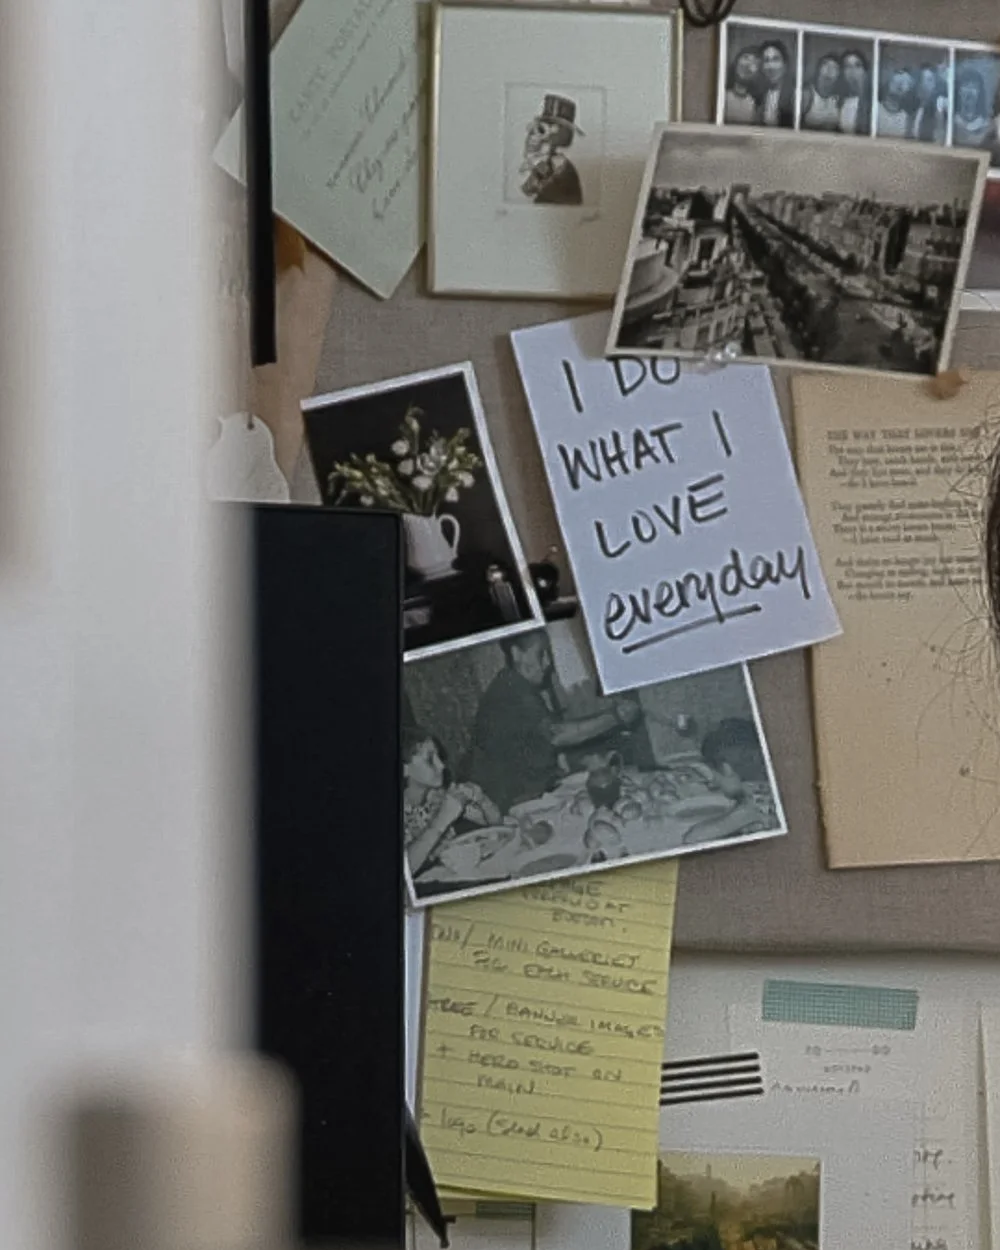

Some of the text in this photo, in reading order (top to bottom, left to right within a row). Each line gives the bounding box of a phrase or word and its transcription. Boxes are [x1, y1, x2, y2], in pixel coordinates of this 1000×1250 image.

[562, 355, 681, 413] I DO
[558, 410, 732, 491] WHAT I
[595, 474, 728, 559] LOVE
[604, 546, 810, 641] everyday
